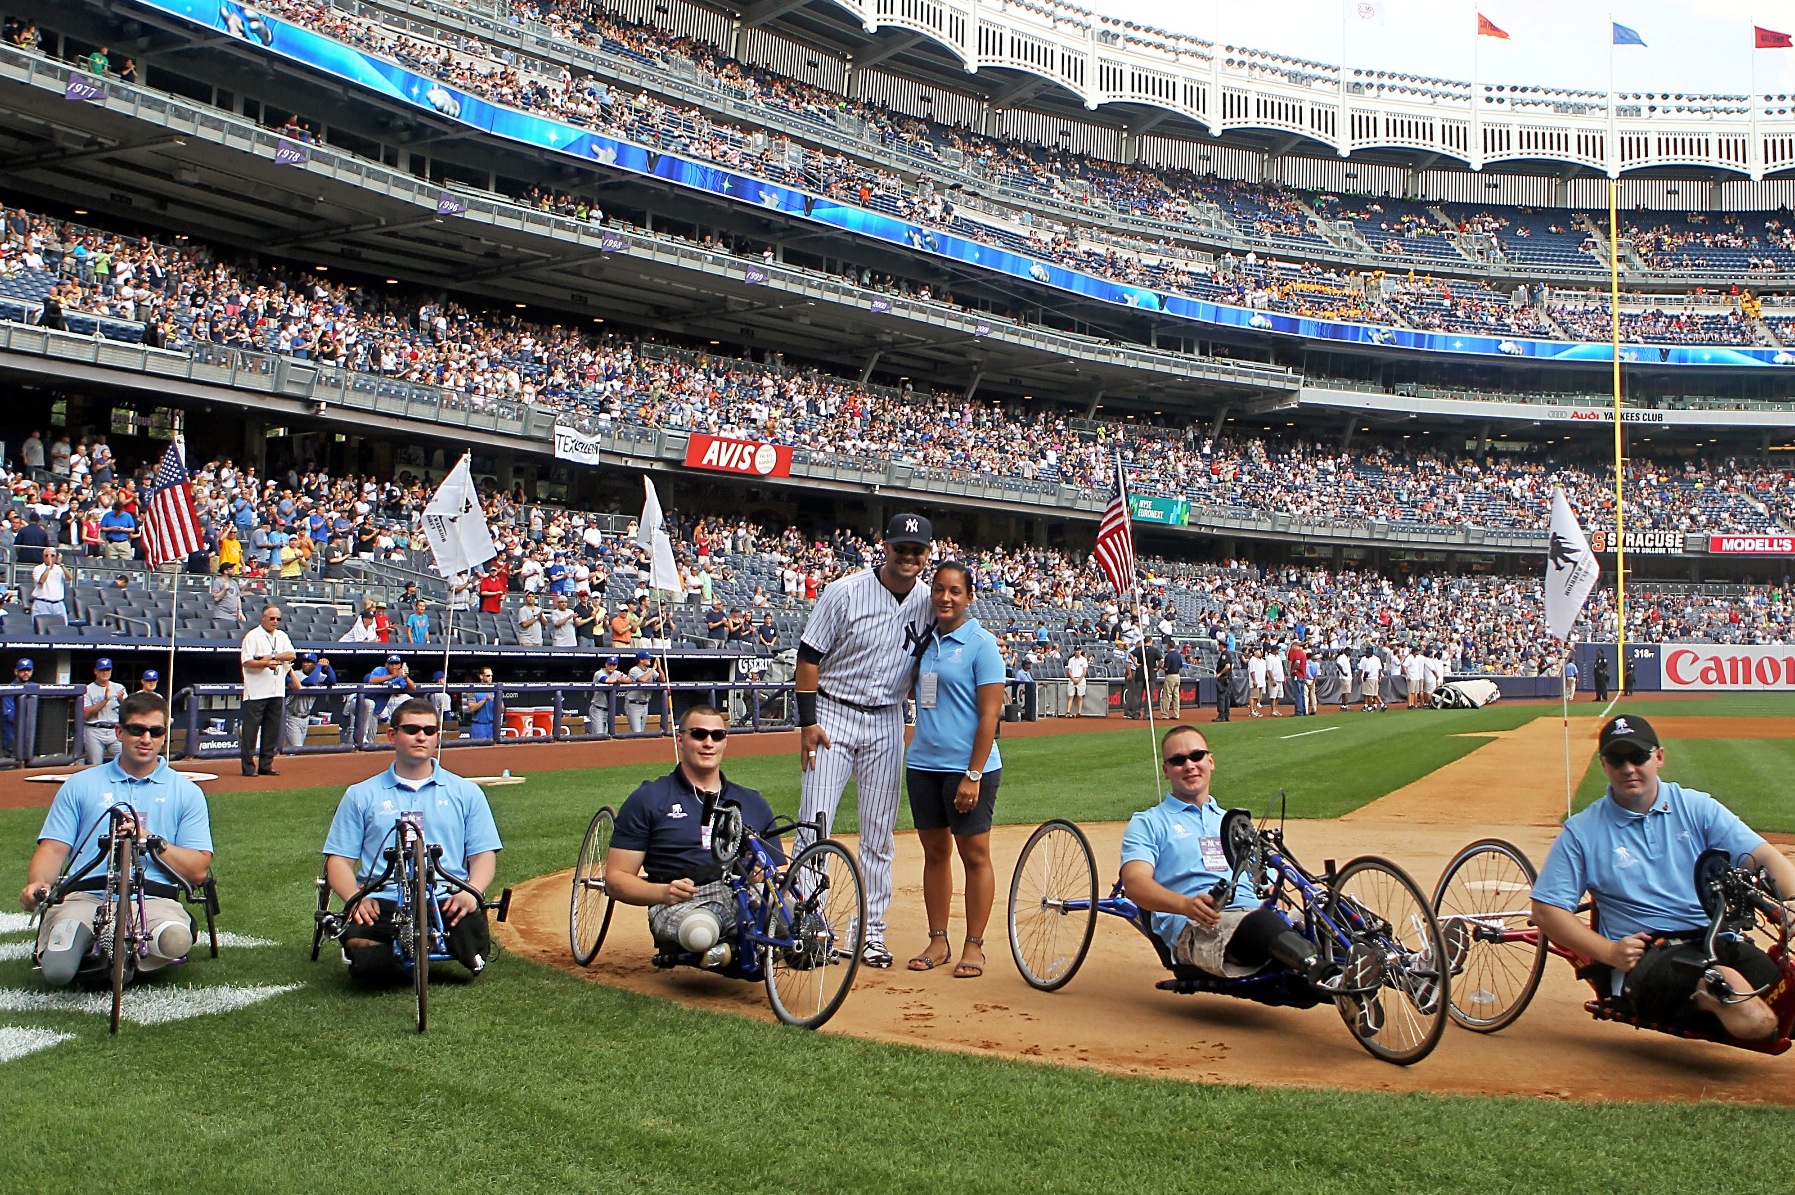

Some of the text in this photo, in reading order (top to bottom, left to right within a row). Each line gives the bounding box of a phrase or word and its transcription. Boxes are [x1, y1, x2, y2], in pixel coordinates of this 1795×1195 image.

[67, 82, 97, 98] 1977
[276, 148, 300, 162] 1978
[438, 200, 460, 212] 1996
[602, 238, 623, 249] 1998
[746, 271, 764, 282] 1999
[1570, 410, 1663, 422] Audi YAKEES CLUB
[702, 440, 756, 470] AVIS
[1139, 500, 1152, 508] NYSE
[906, 518, 918, 532] NY
[1592, 530, 1606, 552] S
[1722, 538, 1792, 552] MODELL'S
[1108, 691, 1120, 704] udi
[1180, 688, 1196, 701] Audi
